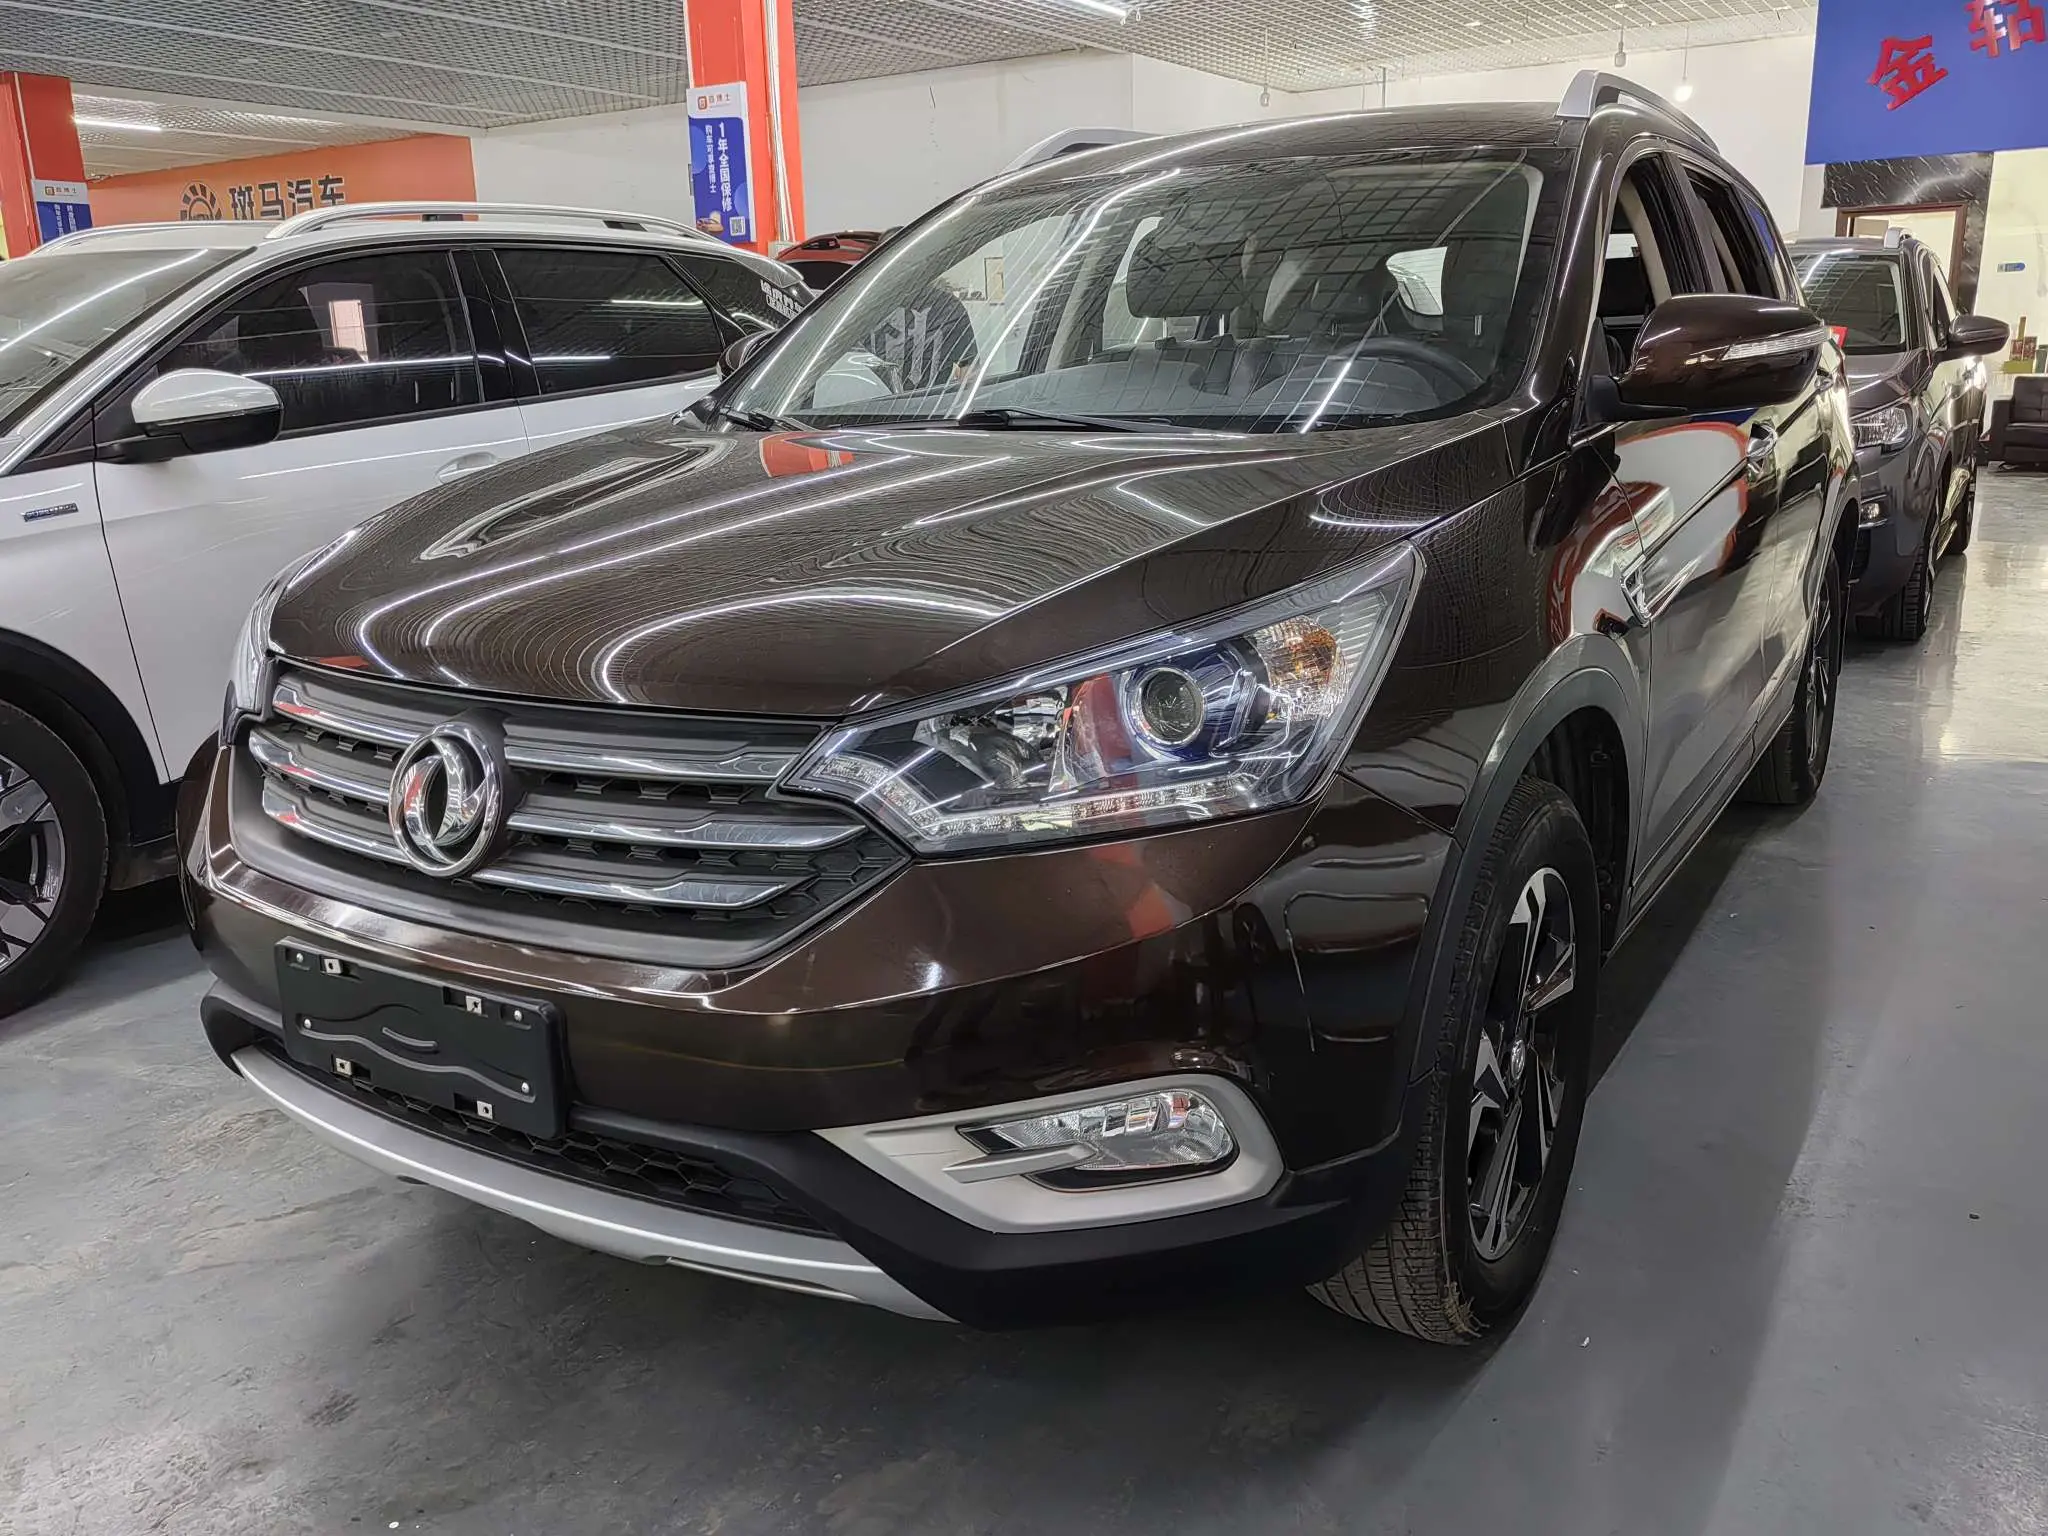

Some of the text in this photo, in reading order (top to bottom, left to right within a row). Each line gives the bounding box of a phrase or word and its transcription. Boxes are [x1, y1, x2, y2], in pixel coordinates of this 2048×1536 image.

[228, 174, 345, 220] 斑马汽车
[717, 121, 733, 213] 1年全国保修
